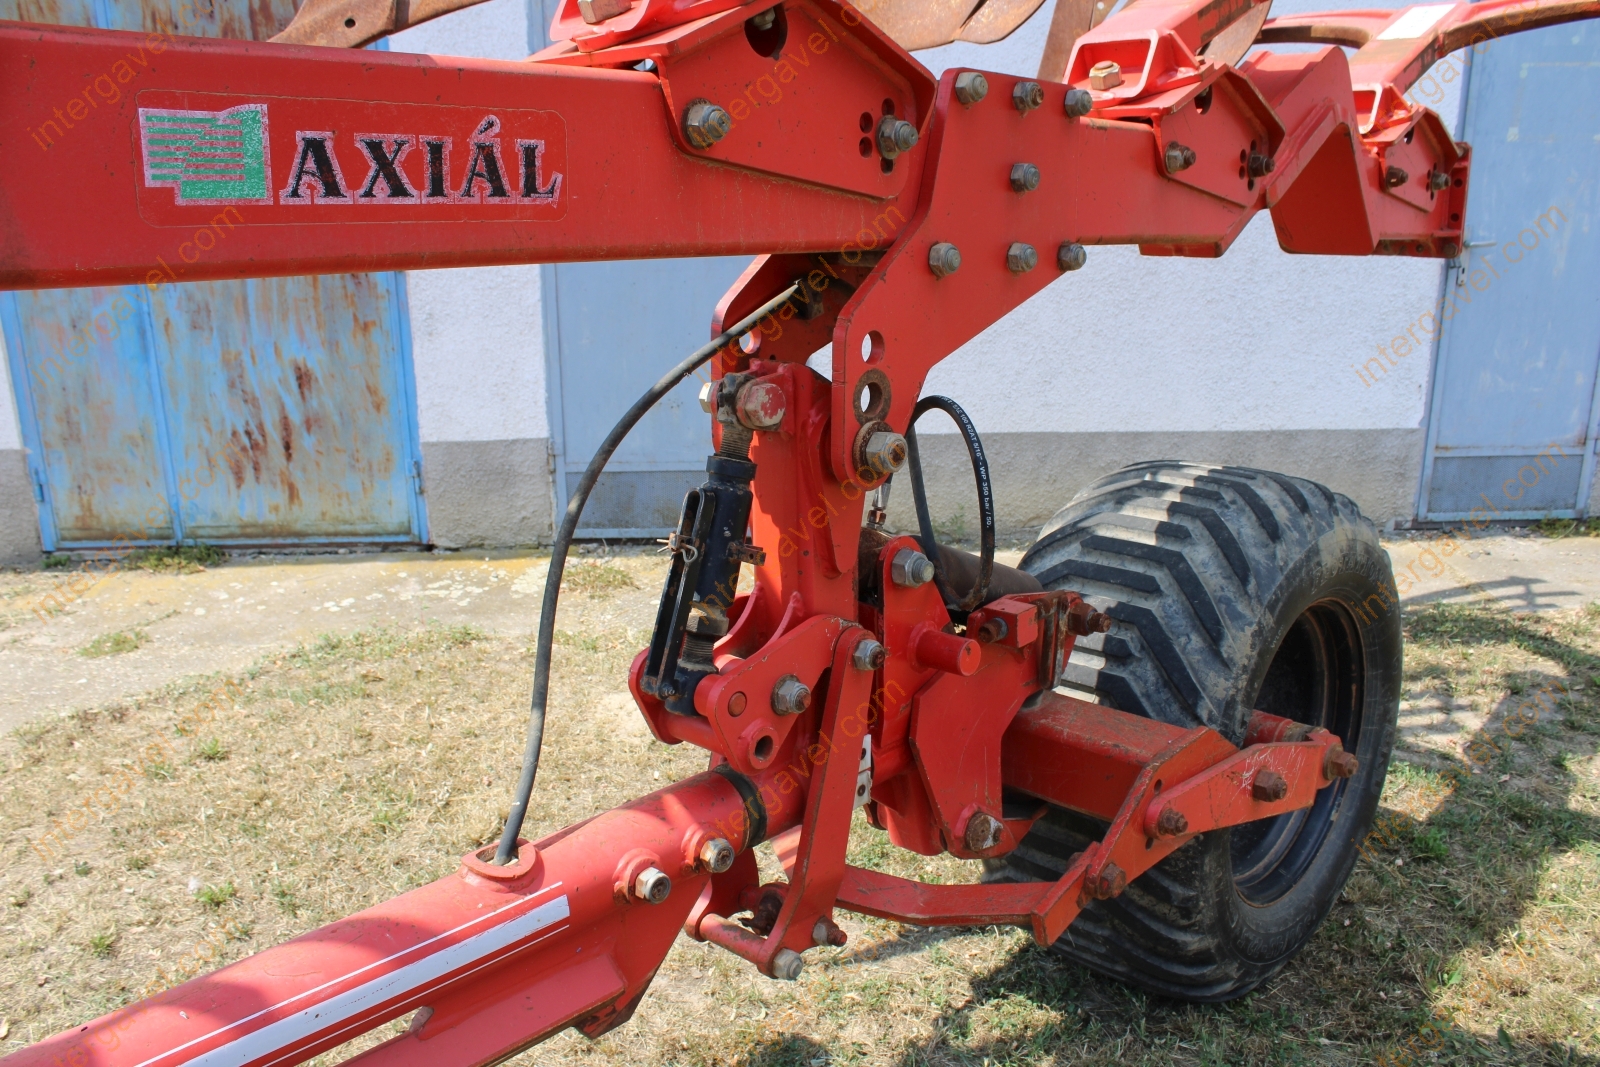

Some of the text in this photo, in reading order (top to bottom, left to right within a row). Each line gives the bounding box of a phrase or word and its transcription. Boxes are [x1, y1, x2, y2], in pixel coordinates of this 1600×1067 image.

[280, 114, 563, 208] AXIÁL
[960, 414, 969, 424] 100
[966, 424, 977, 441] R2AT
[980, 466, 987, 479] WP
